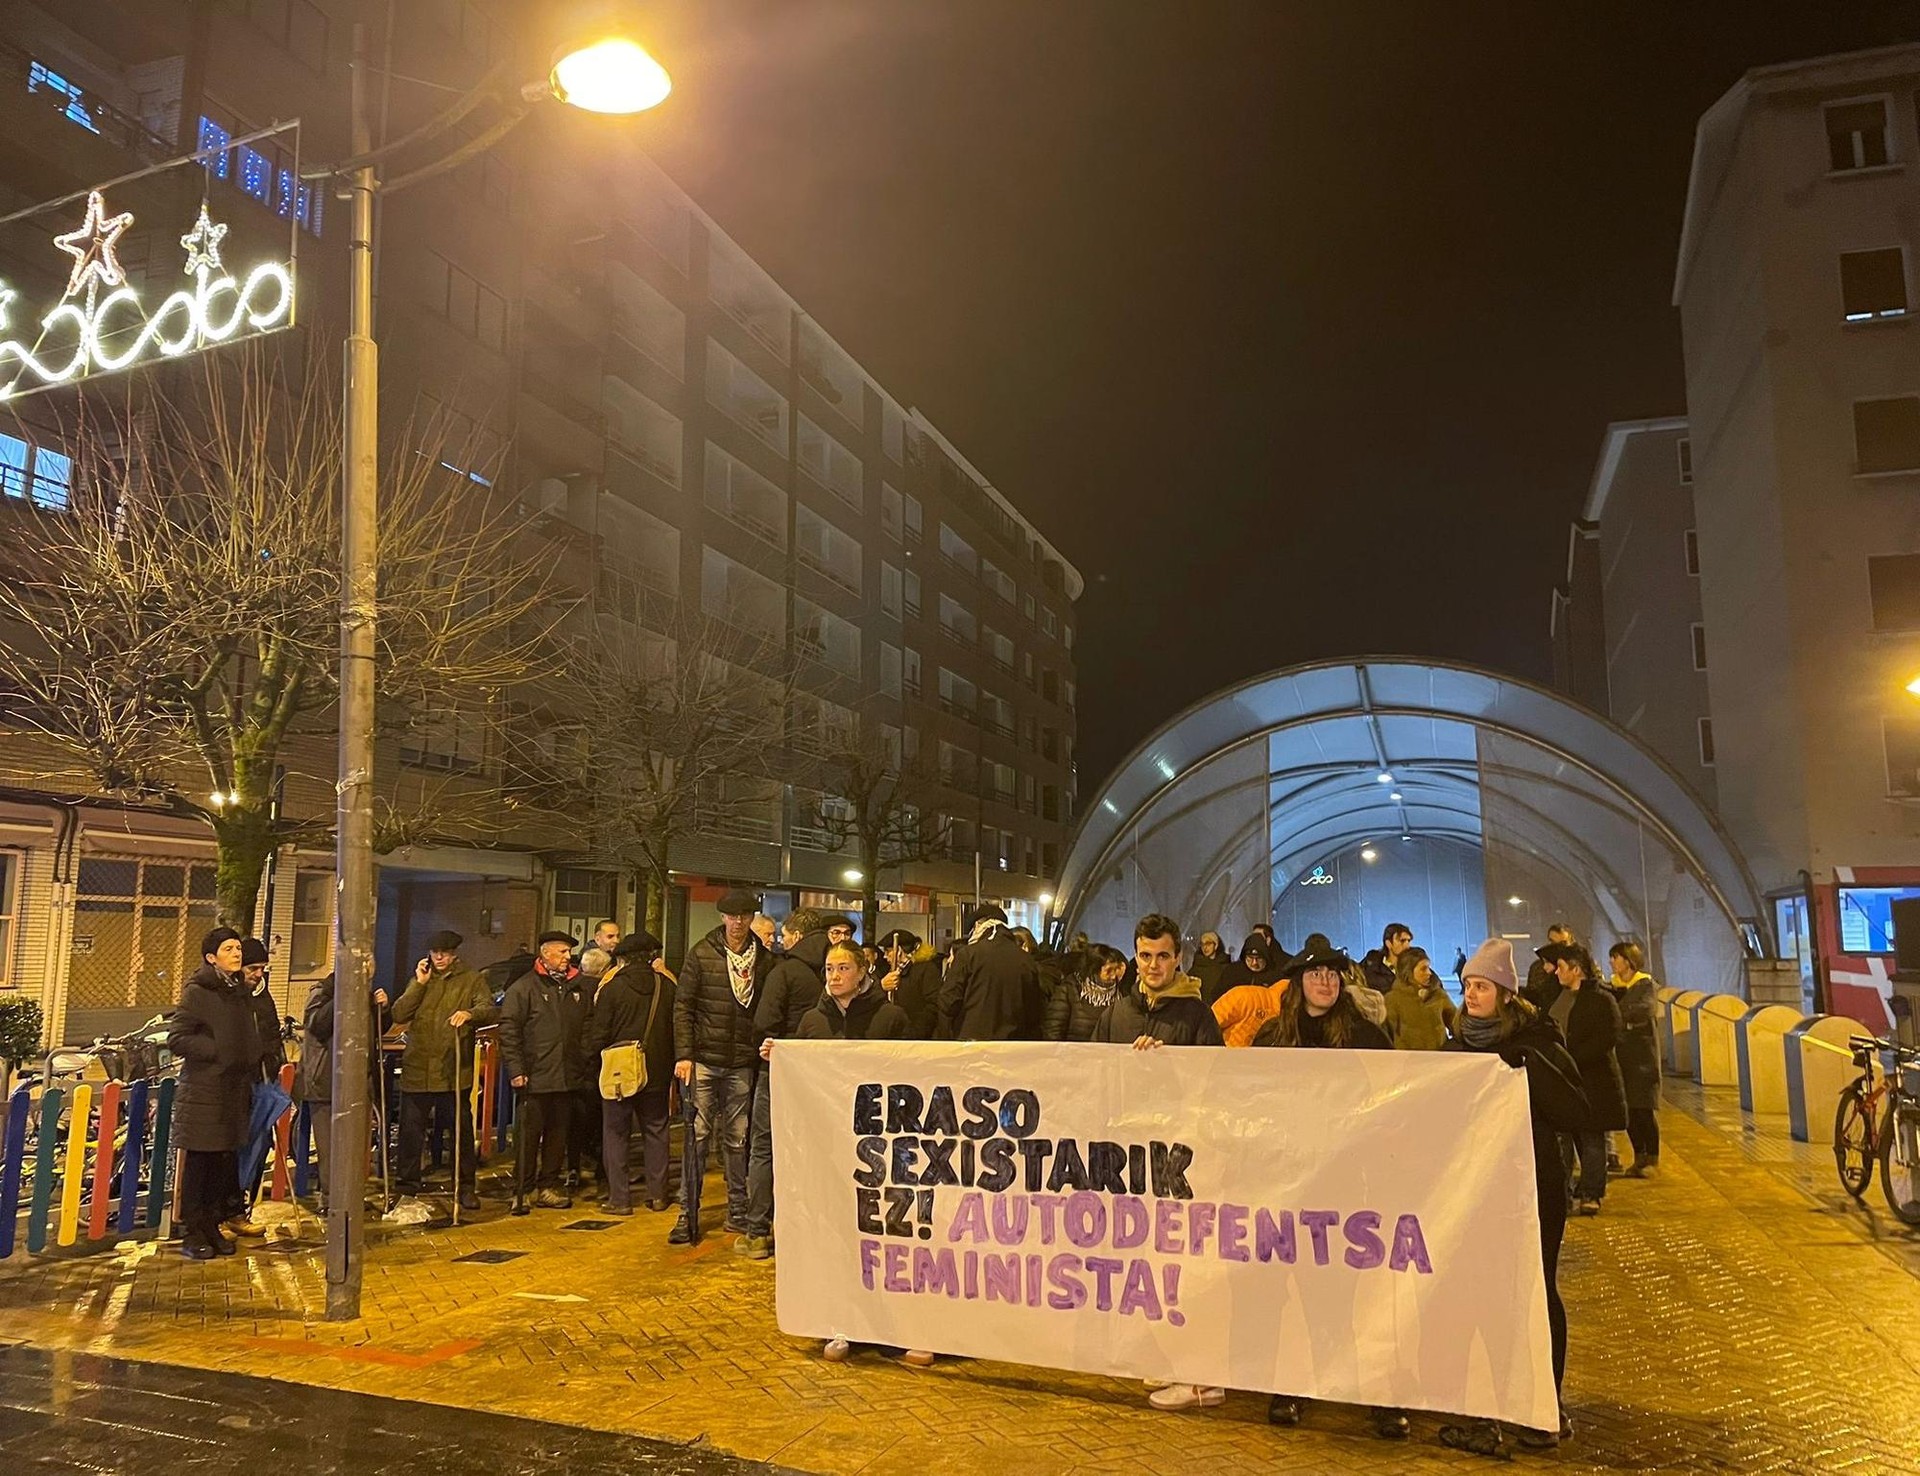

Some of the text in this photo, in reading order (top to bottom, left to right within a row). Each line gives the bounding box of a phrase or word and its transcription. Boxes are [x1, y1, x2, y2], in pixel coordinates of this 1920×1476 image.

[853, 1083, 1040, 1139] ERASO
[853, 1136, 1194, 1199] SEXISTARIK
[856, 1188, 1433, 1274] EZ! AUTODEFENTSA
[860, 1239, 1186, 1326] FEMINISTA!
